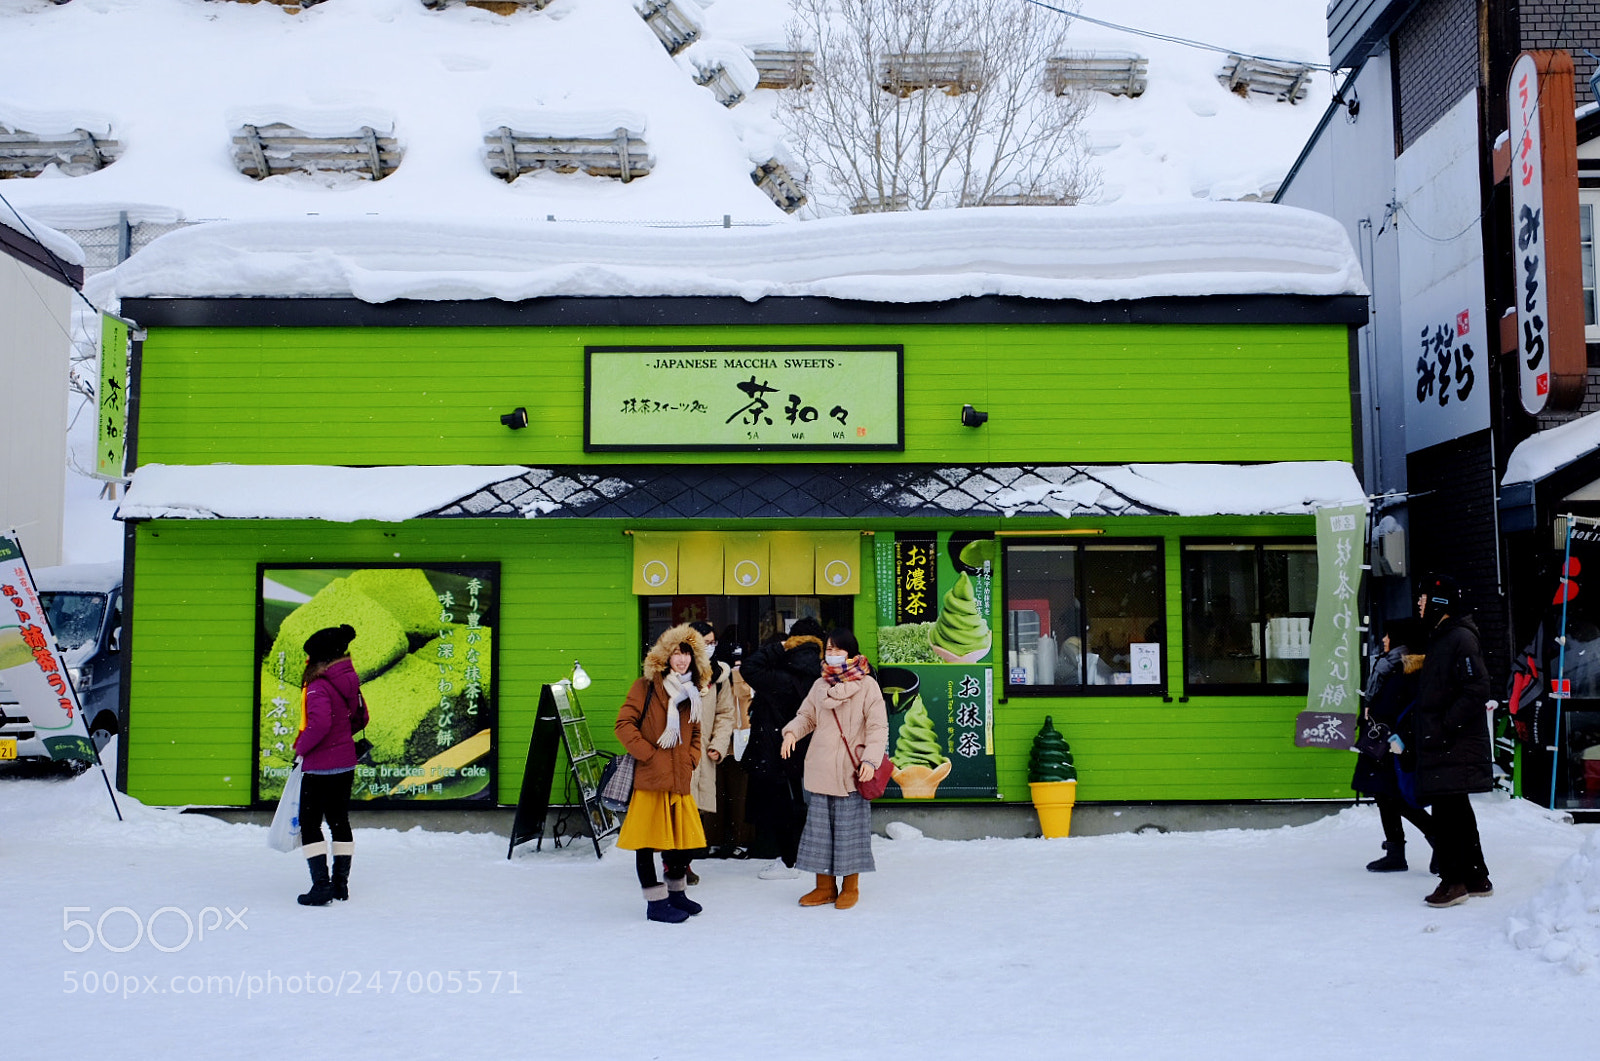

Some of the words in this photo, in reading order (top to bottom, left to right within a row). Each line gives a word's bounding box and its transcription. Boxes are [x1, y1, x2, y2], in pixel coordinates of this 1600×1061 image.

[1519, 72, 1533, 187] ラーメン
[653, 358, 717, 369] JAPANESE
[724, 358, 778, 369] MACCHA
[784, 358, 835, 369] SWEETS
[104, 375, 122, 464] 茶和々
[620, 397, 708, 415] 抹茶スイーツ処
[725, 375, 849, 426] 茶和々
[746, 431, 760, 440] SA
[792, 431, 805, 440] WA
[832, 431, 845, 440] WA
[905, 544, 927, 616] お濃茶
[437, 591, 455, 747] 味わい深いわらび餅
[466, 578, 483, 716] 香り豊かな抹茶と
[266, 696, 290, 752] 茶和々
[957, 674, 982, 758] お抹茶
[263, 766, 292, 777] Powd
[357, 766, 376, 777] tea
[380, 764, 425, 777] bracken
[430, 764, 456, 777] rice
[460, 764, 487, 777] cake
